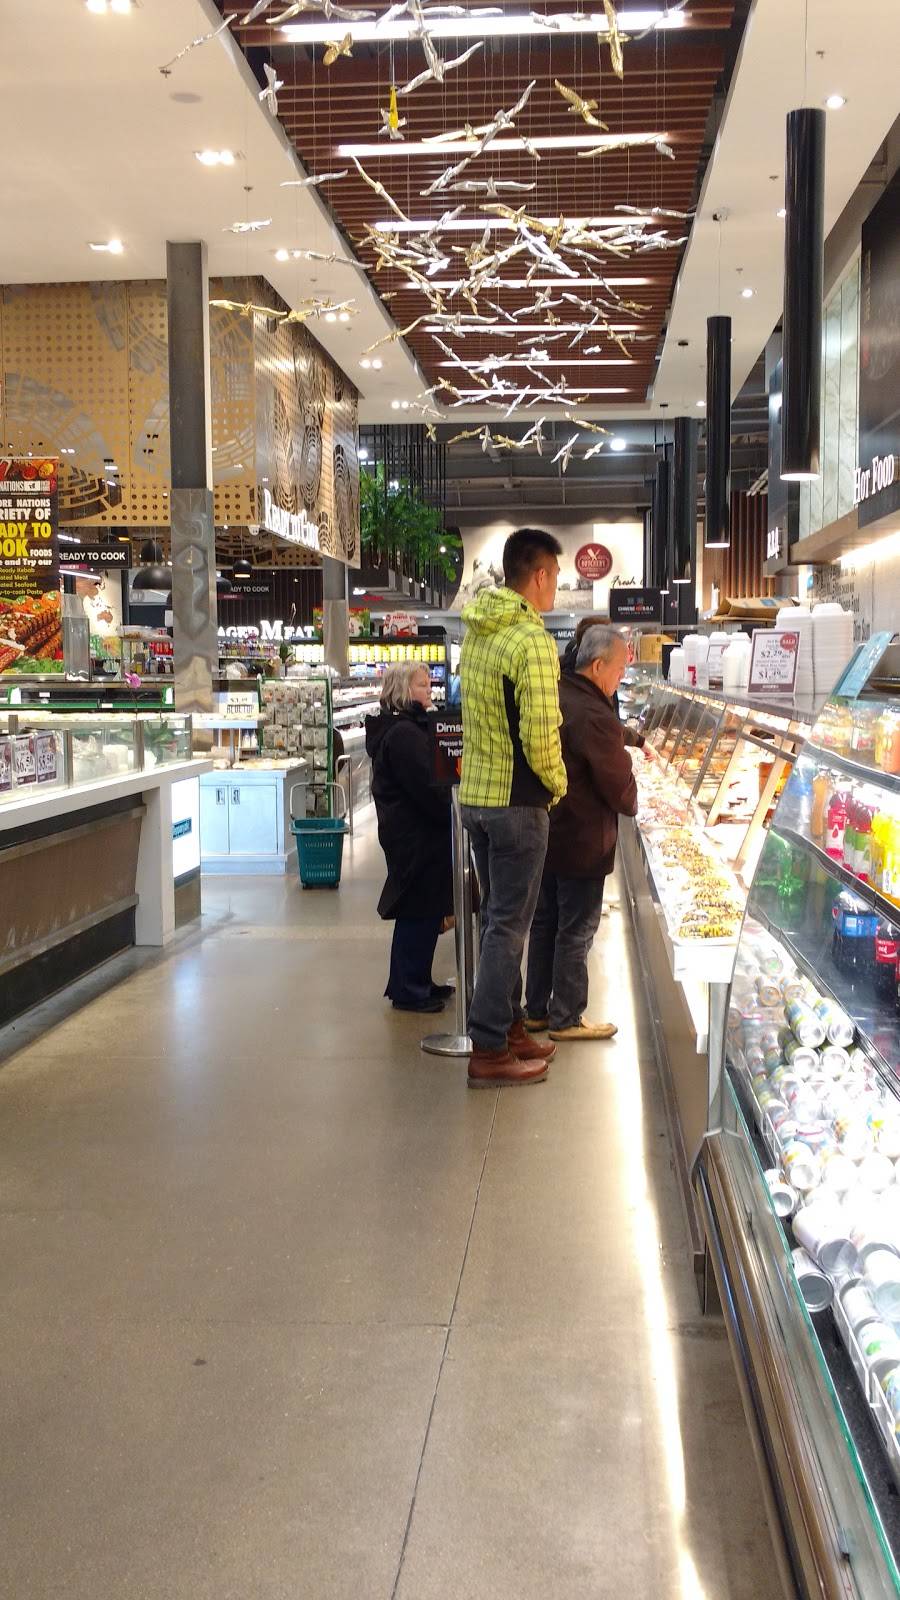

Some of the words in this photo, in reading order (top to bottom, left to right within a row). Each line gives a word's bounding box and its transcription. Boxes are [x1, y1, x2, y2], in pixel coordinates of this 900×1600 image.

[17, 499, 50, 507] NATIONS
[35, 508, 51, 520] OF
[32, 523, 51, 538] TO
[0, 539, 29, 557] OK
[30, 549, 52, 557] FOODS
[59, 552, 86, 561] READY
[87, 552, 99, 561] TO
[100, 552, 125, 561] COOK
[5, 558, 21, 566] and
[22, 558, 37, 567] Try
